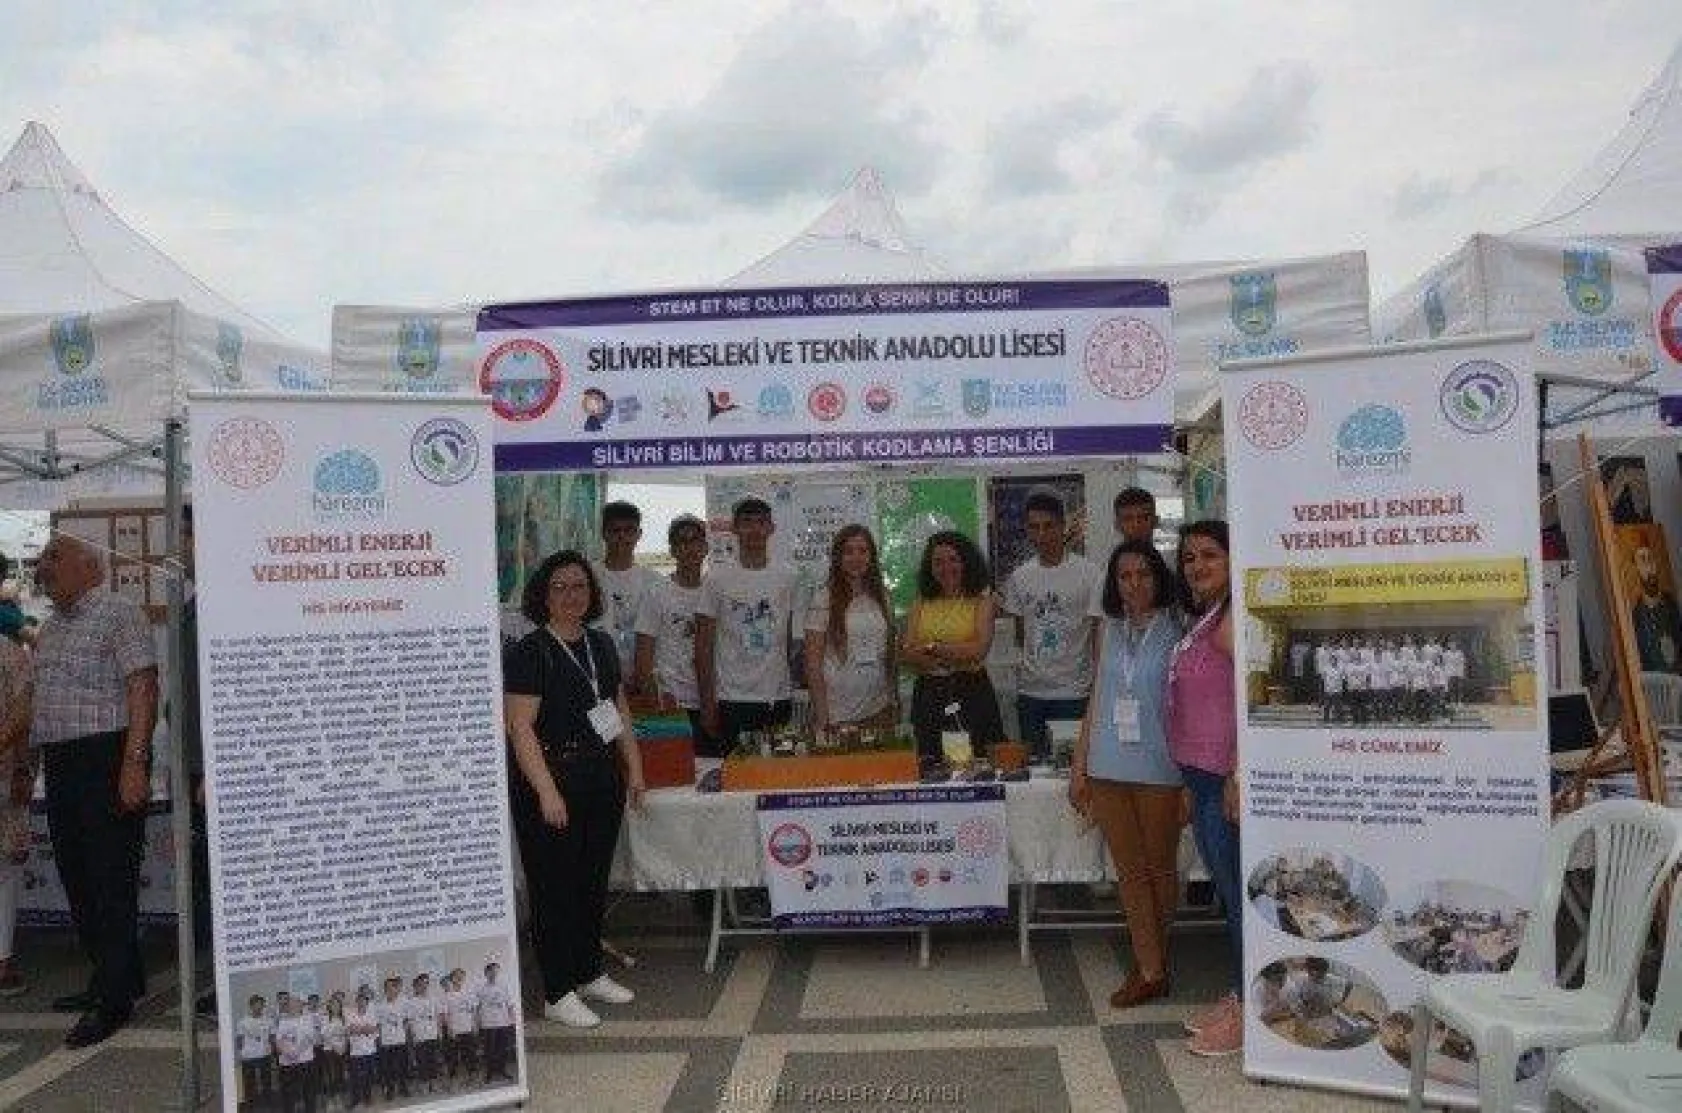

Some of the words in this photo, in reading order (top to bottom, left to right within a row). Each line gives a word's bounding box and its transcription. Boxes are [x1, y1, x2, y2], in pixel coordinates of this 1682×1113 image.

[701, 299, 725, 315] ET
[727, 298, 750, 314] NE
[937, 289, 962, 306] DE
[587, 341, 662, 371] SİLİVRİ
[667, 337, 759, 368] MESLEKİ
[766, 342, 793, 364] VE
[797, 333, 880, 364] TEKNİK
[885, 333, 995, 361] ANADOLU
[1001, 328, 1067, 357] LİSESİ
[592, 441, 665, 466] SİLİVRİ
[670, 439, 723, 463] BİLİM
[727, 442, 757, 462] VE
[762, 435, 856, 459] ROBOTİK
[862, 437, 964, 457] KODLAMA
[972, 430, 1054, 456] ŞENLİĞİ
[1293, 497, 1380, 523] VERİMLİ
[267, 532, 353, 555] VERİMLİ
[1280, 526, 1366, 551] VERİMLİ
[252, 560, 340, 582] VERİMLİ
